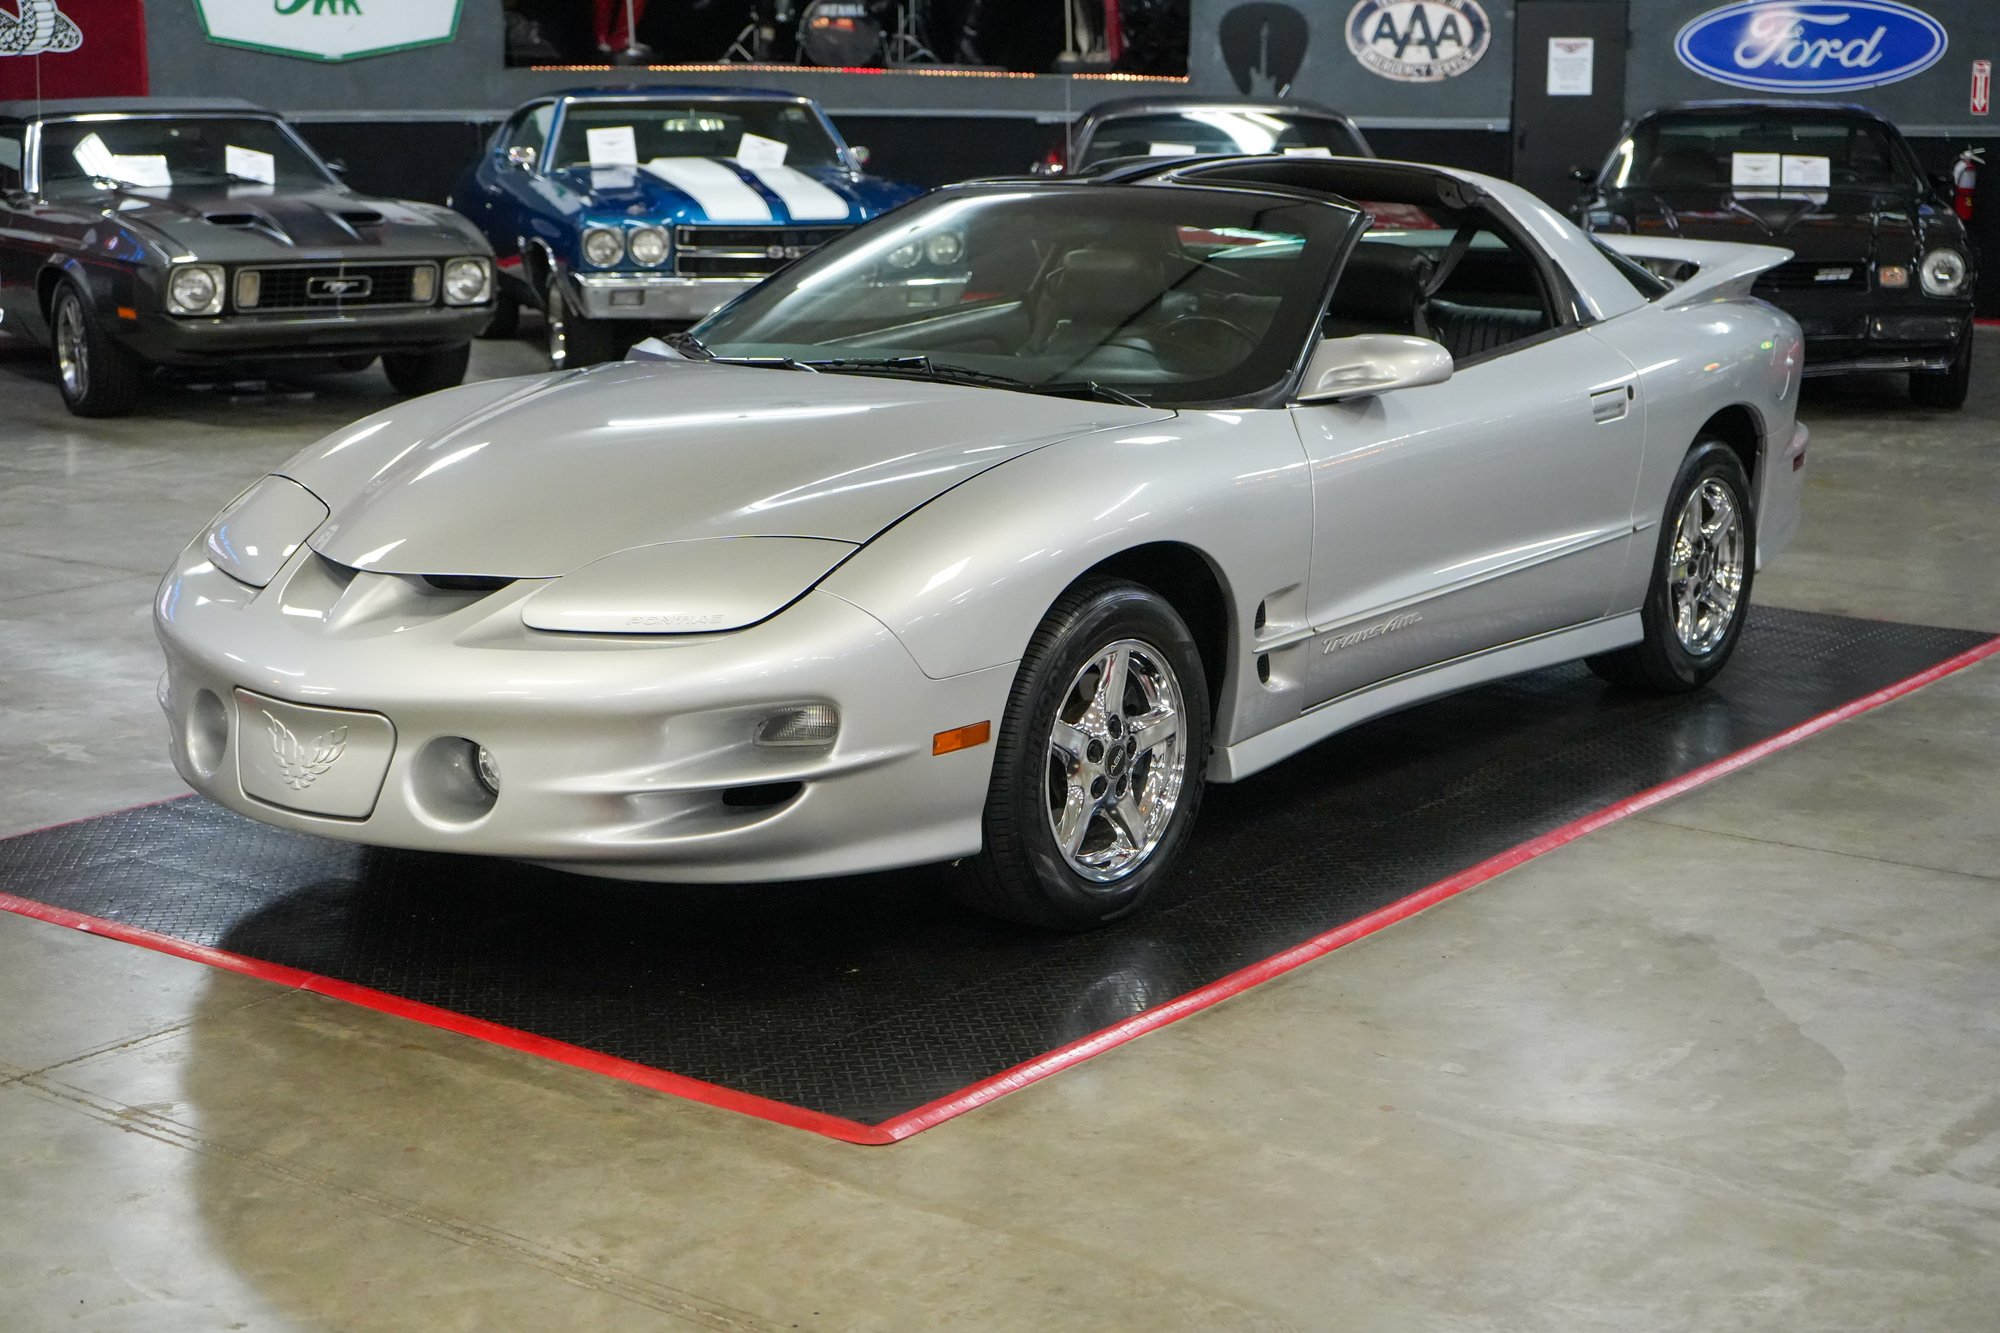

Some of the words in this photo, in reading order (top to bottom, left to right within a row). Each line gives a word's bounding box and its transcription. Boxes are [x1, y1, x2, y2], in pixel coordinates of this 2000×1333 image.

[1372, 5, 1463, 59] AAA
[1734, 10, 1887, 68] Ford
[766, 245, 800, 259] SS
[626, 614, 724, 626] PONTIAC
[1110, 748, 1124, 774] ABS
